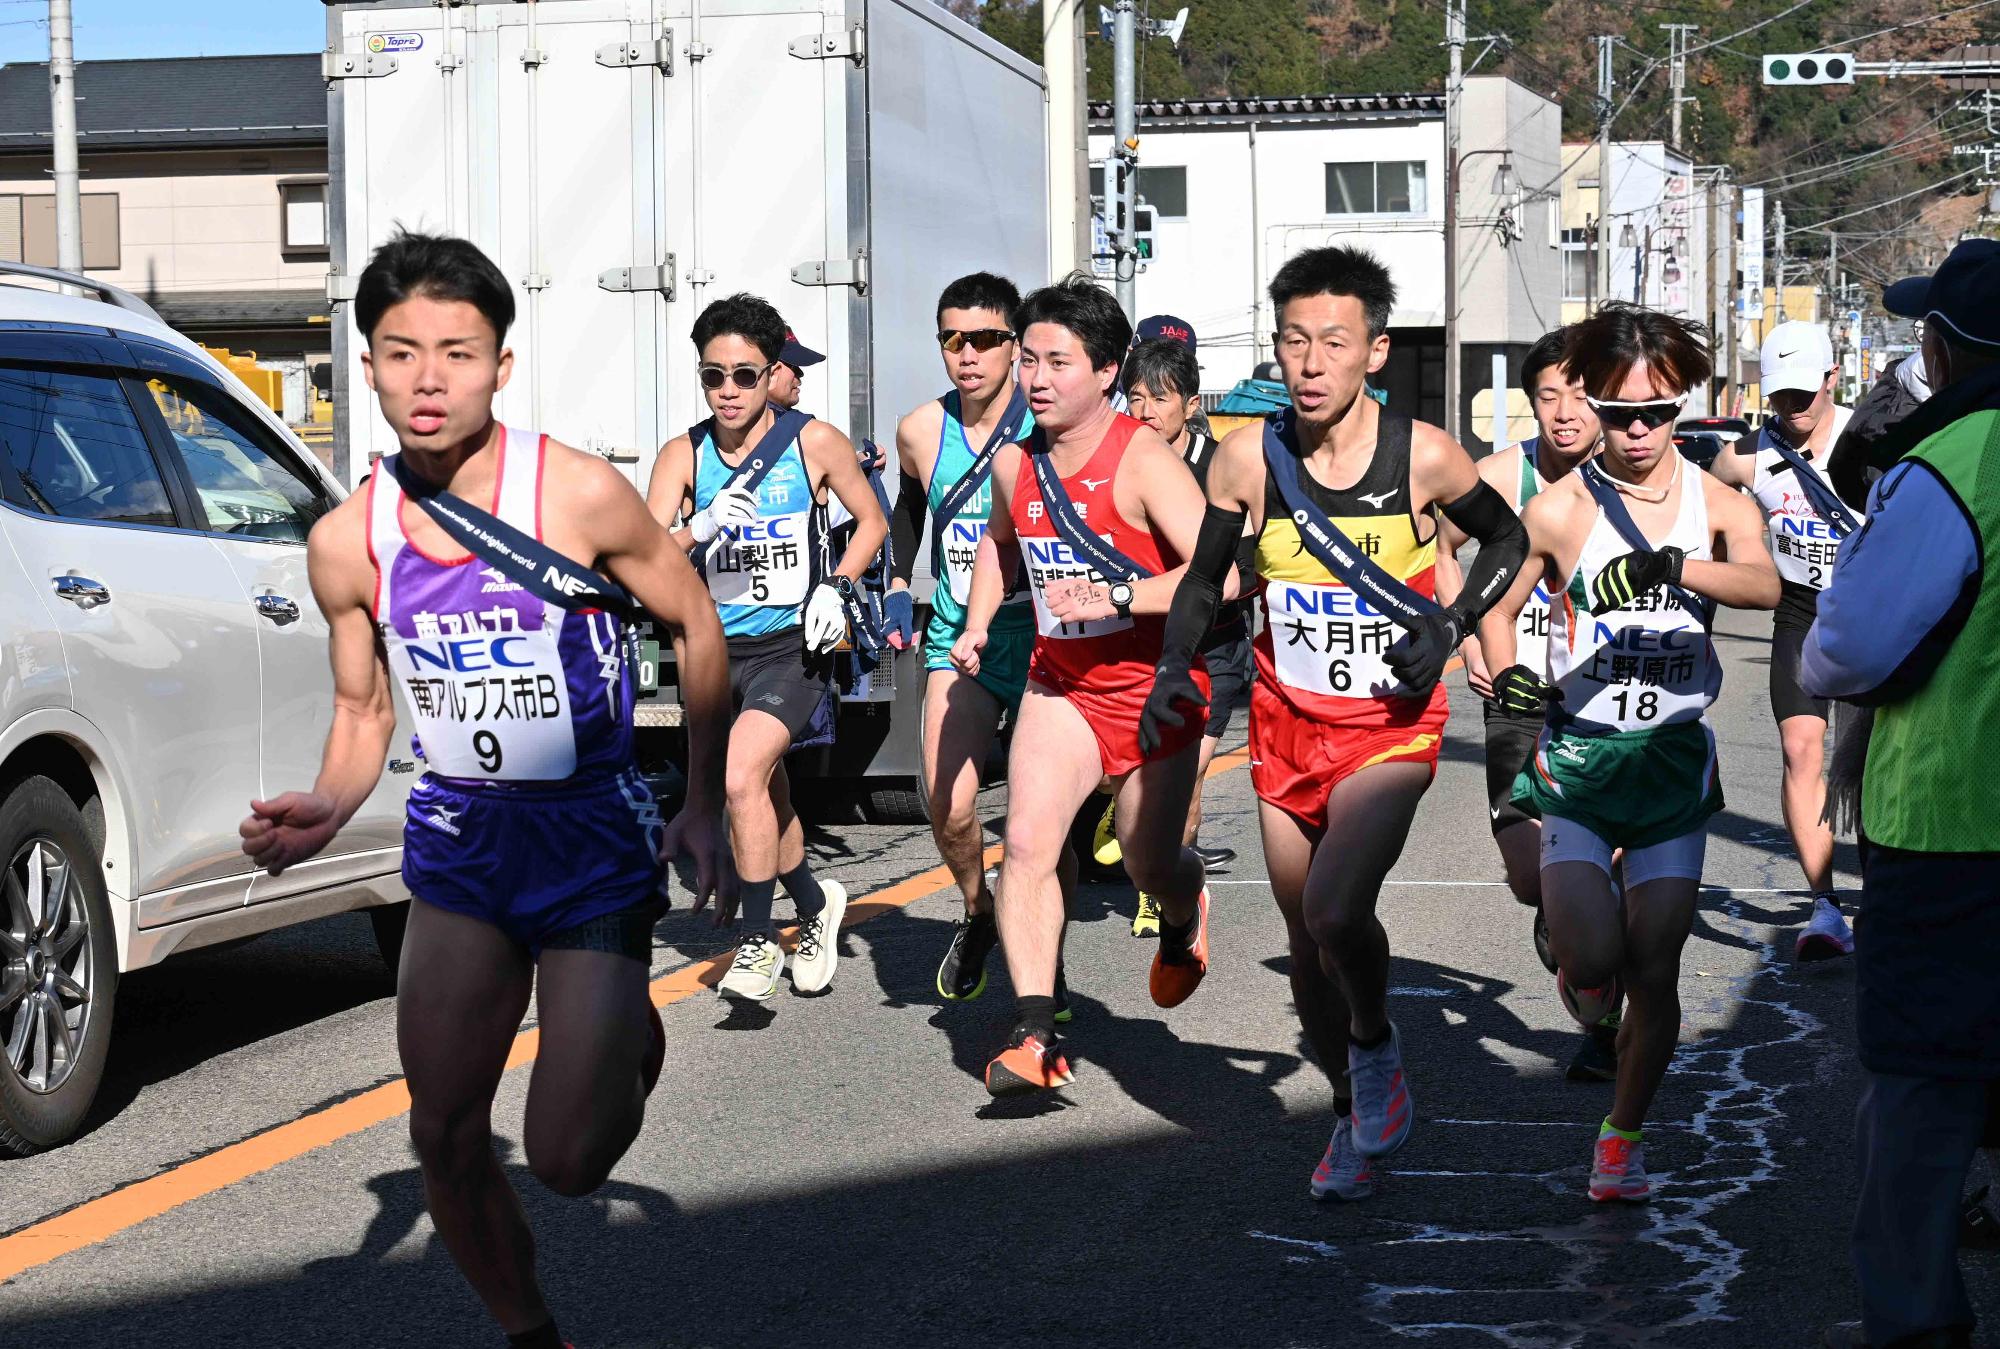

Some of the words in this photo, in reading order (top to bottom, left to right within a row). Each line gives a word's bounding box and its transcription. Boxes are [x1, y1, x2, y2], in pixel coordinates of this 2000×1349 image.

[387, 36, 416, 47] Topre
[479, 530, 512, 556] brighter
[510, 551, 537, 571] world
[716, 542, 798, 574] 山梨市
[751, 575, 769, 601] 5
[1808, 566, 1823, 588] 2
[1284, 618, 1394, 655] 大月市
[1593, 621, 1689, 651] NEC
[405, 636, 535, 673] NEC
[1582, 649, 1696, 687] 上野原市
[1328, 659, 1352, 692] 6
[406, 674, 560, 723] 南アルプス市B
[1611, 690, 1659, 721] 18
[472, 730, 503, 774] 9
